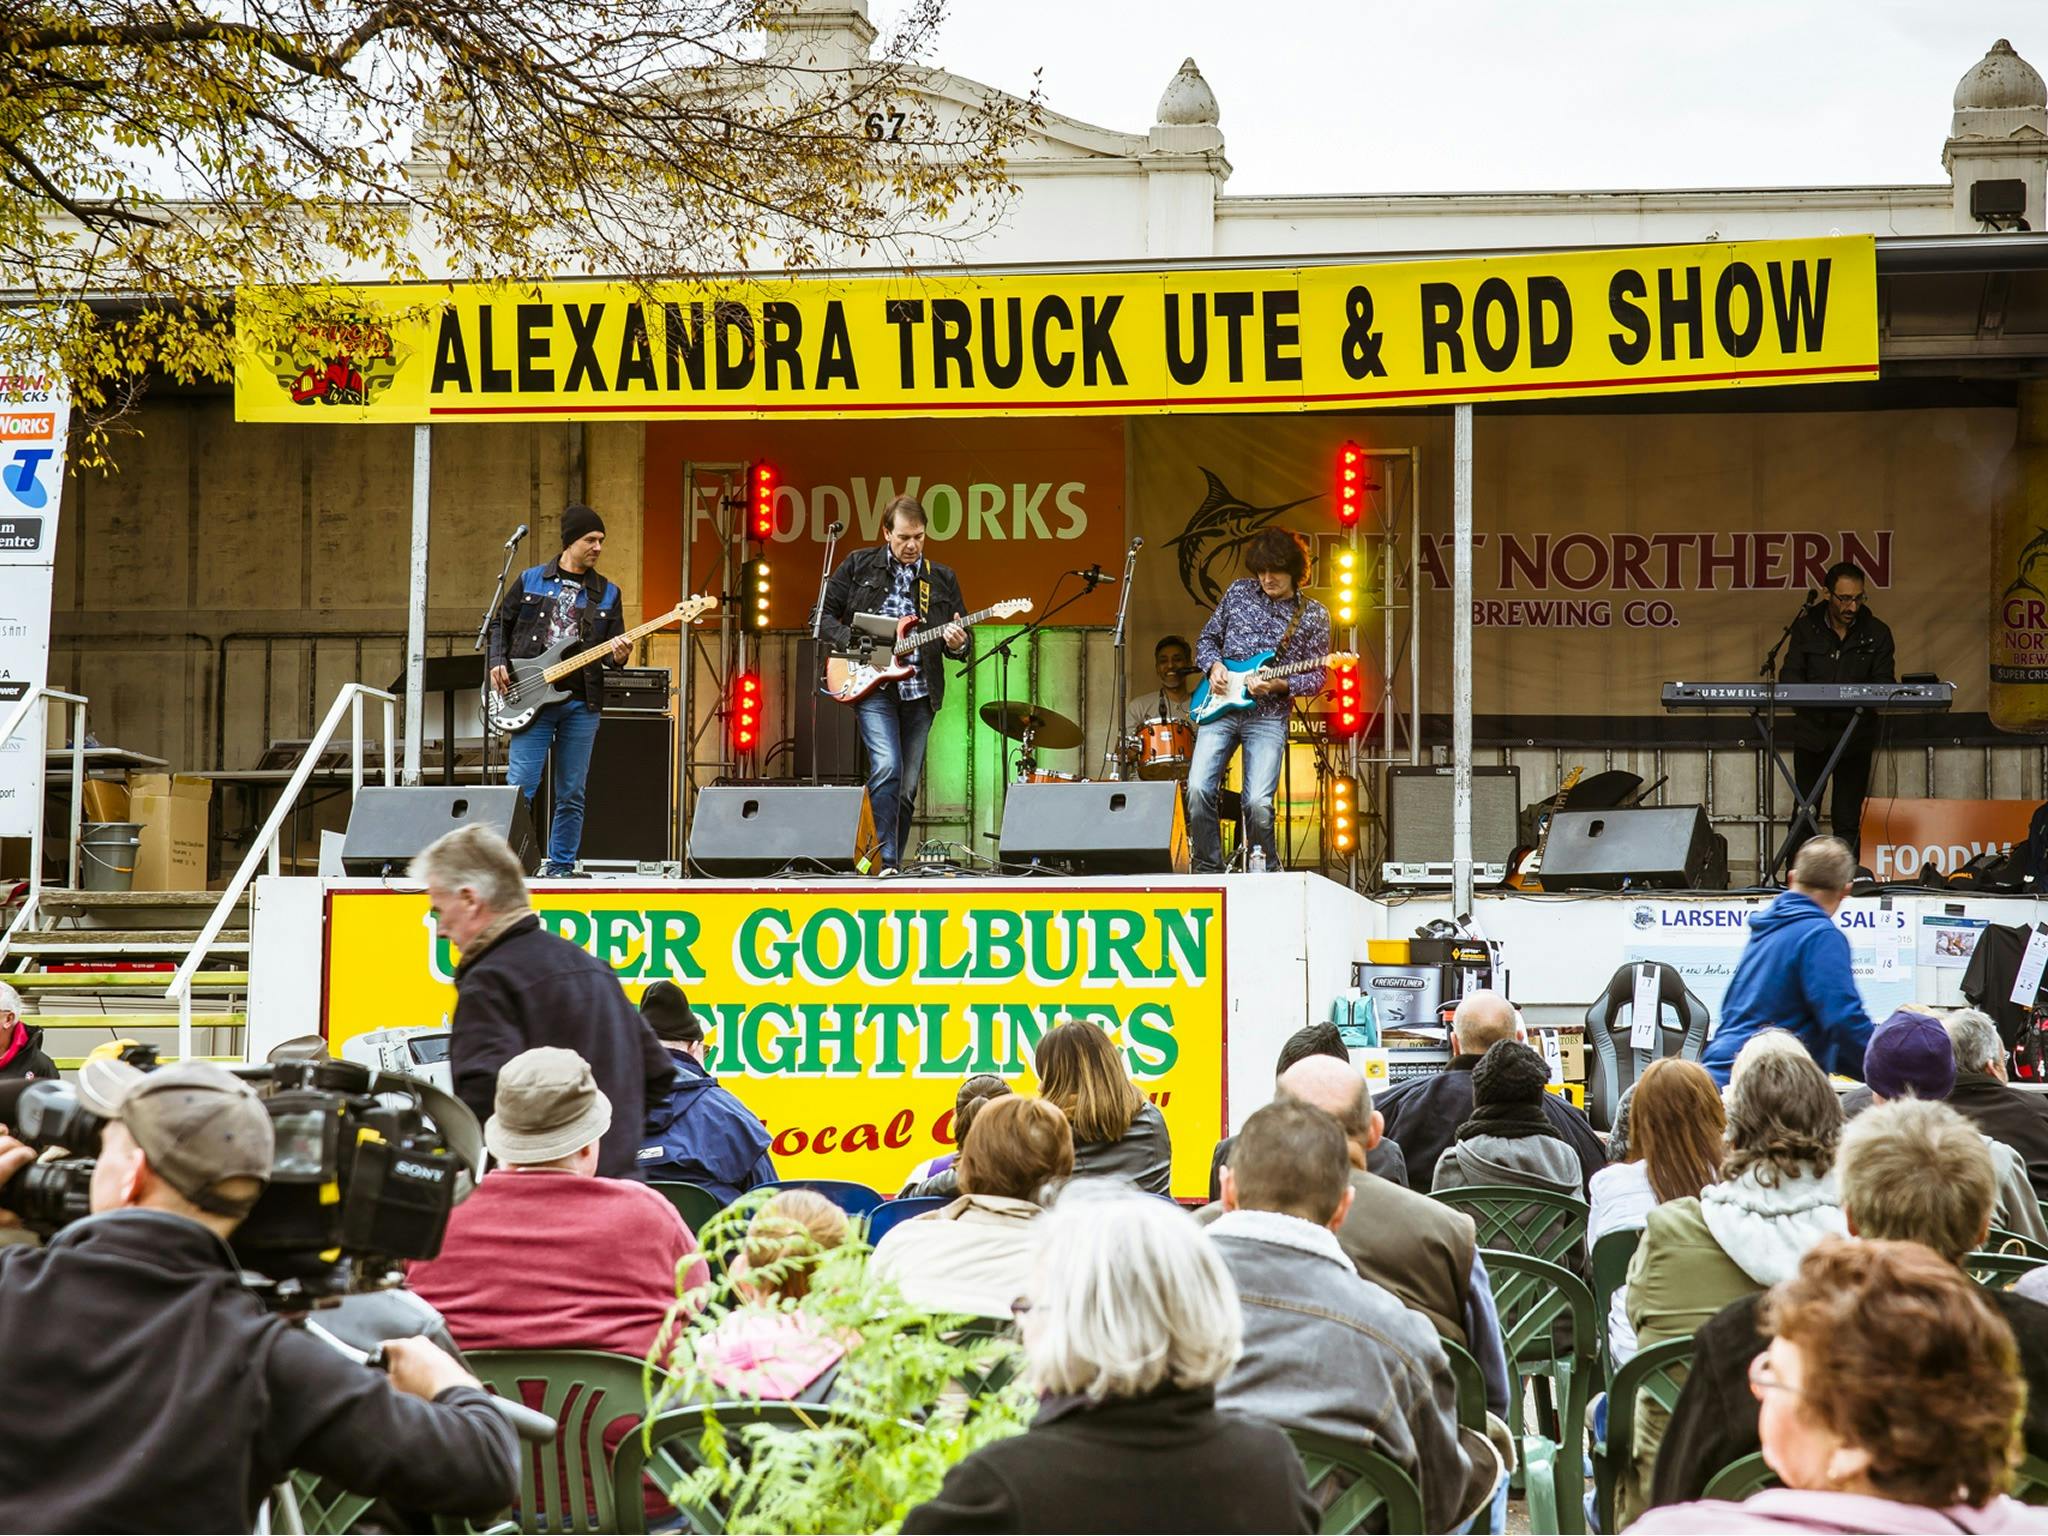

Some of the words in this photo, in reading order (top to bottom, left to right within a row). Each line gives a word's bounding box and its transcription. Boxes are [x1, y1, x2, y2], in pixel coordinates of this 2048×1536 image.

[430, 301, 860, 394] ALEXANDRA
[886, 294, 1129, 389] TRUCK
[1164, 290, 1303, 385] UTE
[1341, 285, 1388, 380] &
[1420, 275, 1574, 375] ROD
[1608, 257, 1832, 366] SHOW
[1496, 530, 1895, 590] NORTHERN
[1471, 600, 1612, 628] BREWING
[1623, 600, 1681, 628] CO.
[1661, 909, 1758, 927] LARSEN'
[1840, 910, 1906, 928] SALS
[427, 909, 707, 980] PER
[738, 905, 1215, 984] GOULBURN
[1374, 977, 1424, 988] FREIGHTLINER
[759, 1108, 915, 1158] ocal
[394, 1160, 446, 1182] SONY
